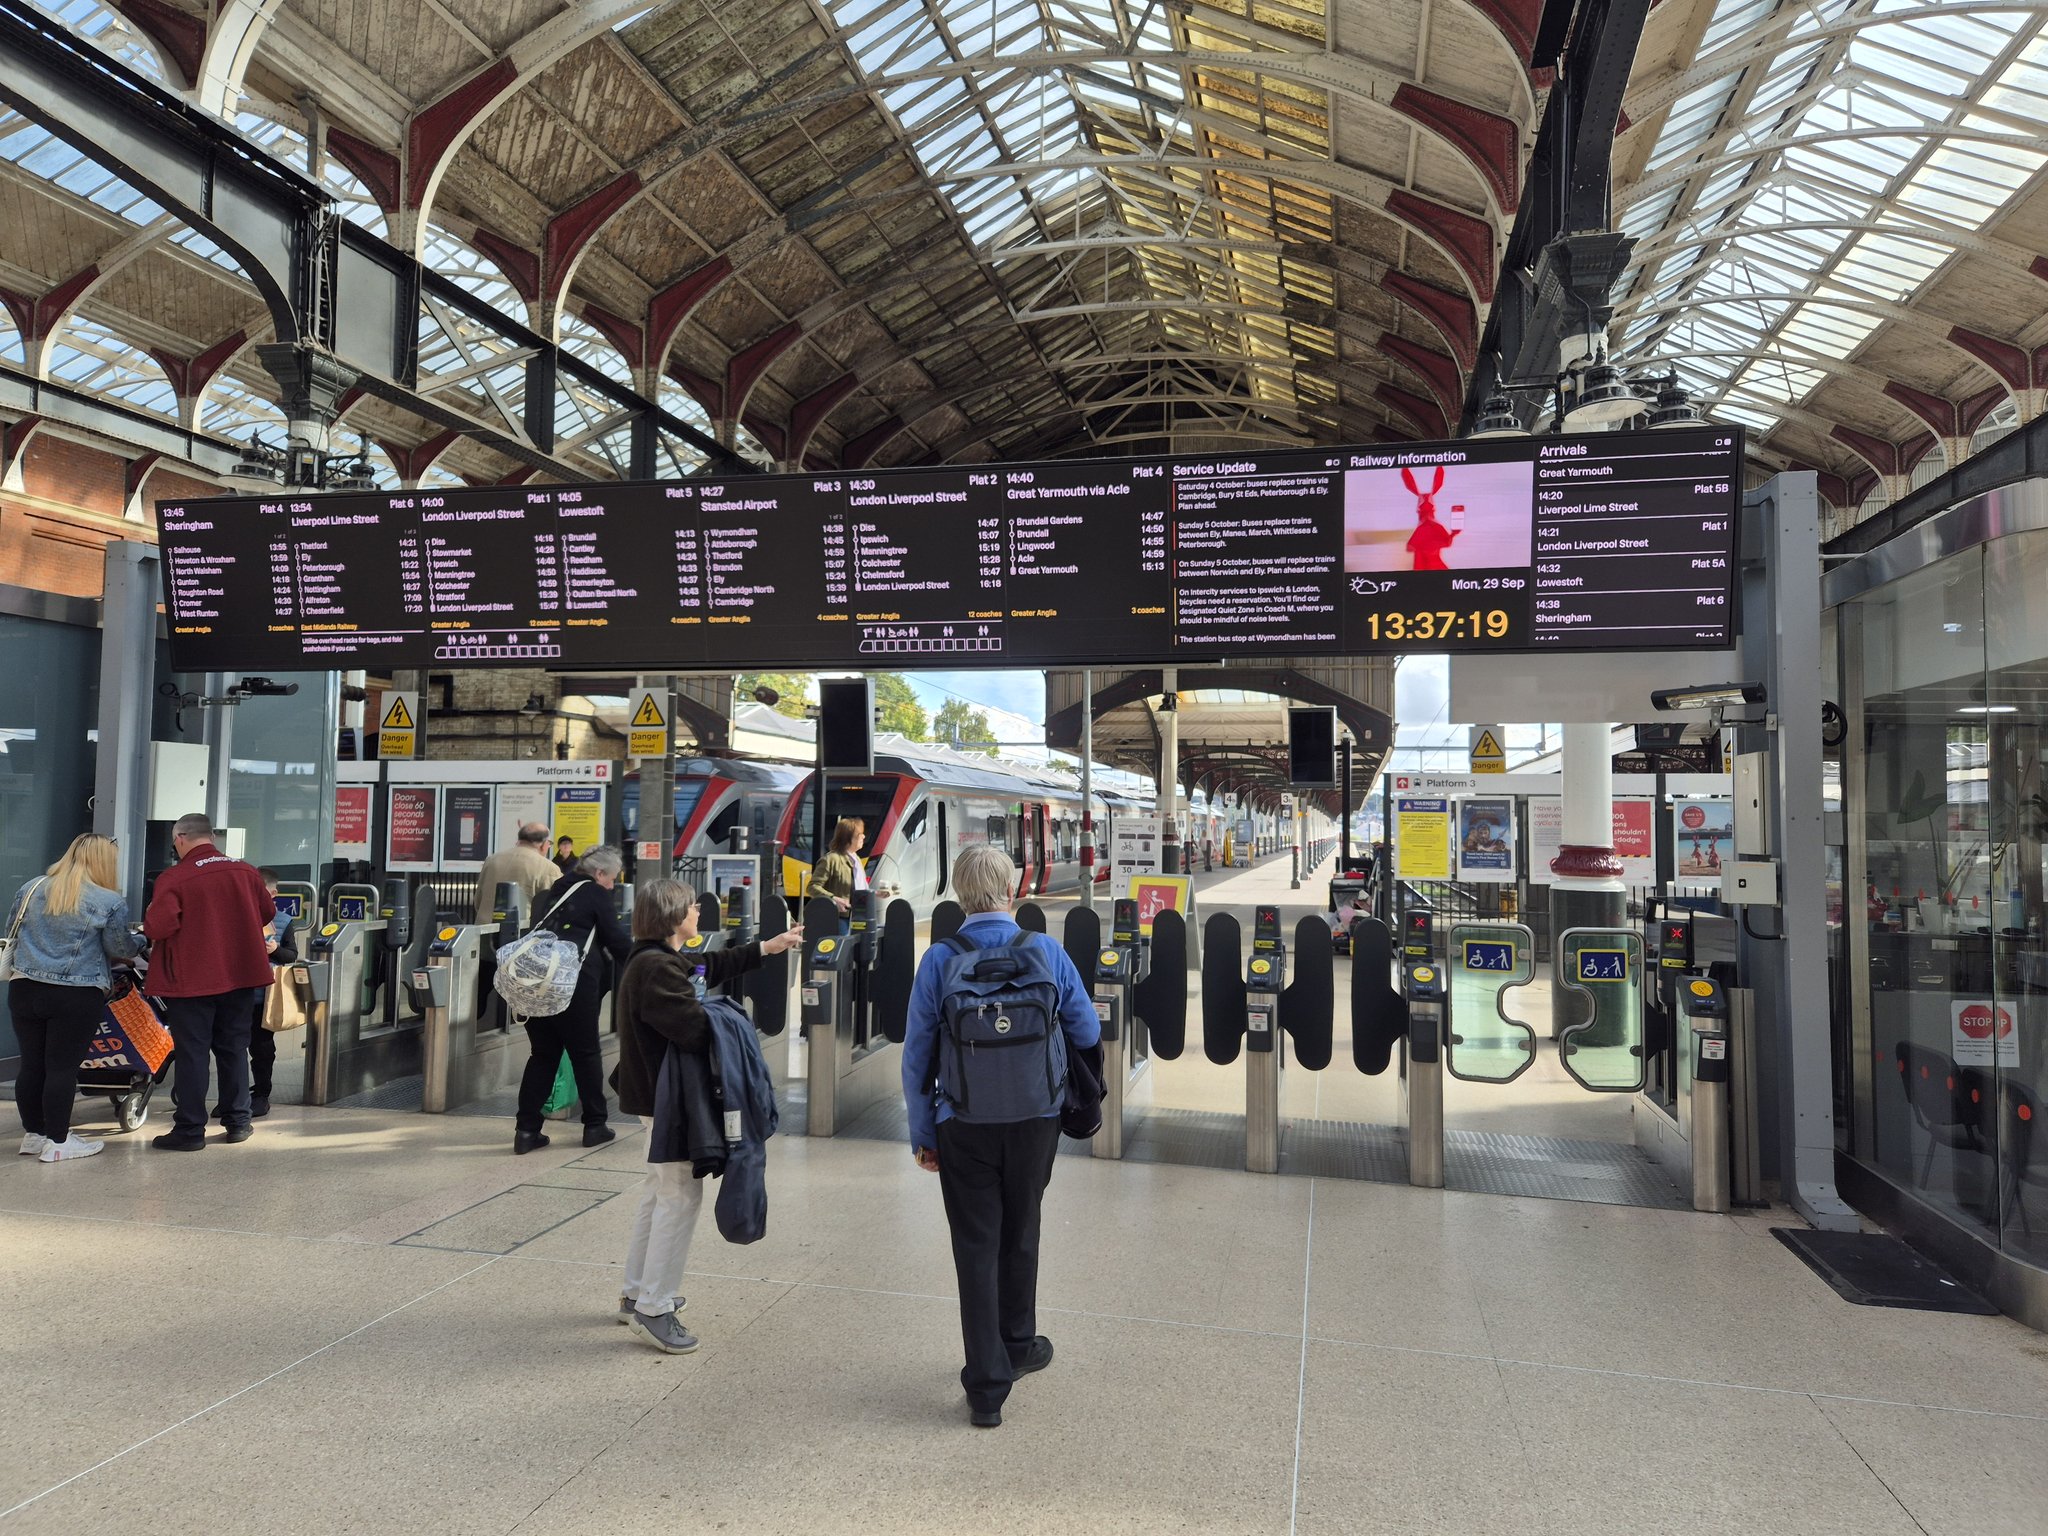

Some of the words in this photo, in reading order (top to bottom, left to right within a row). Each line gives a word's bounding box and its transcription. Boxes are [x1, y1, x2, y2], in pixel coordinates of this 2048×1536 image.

[1540, 444, 1588, 457] Arrivals
[1351, 456, 1396, 467] Railway
[1398, 451, 1467, 464] Information
[1133, 467, 1153, 477] Plat
[1155, 466, 1163, 476] 4
[1173, 464, 1214, 475] Service
[1217, 462, 1258, 475] Update
[1540, 469, 1565, 477] Great
[1568, 466, 1612, 476] Yarmouth
[969, 475, 989, 485] Plat
[990, 474, 997, 484] 2
[1007, 472, 1034, 483] 14:40
[814, 482, 833, 492] Plat
[834, 481, 841, 491] 3
[849, 480, 875, 490] 14:30
[1178, 483, 1210, 491] Saturday
[1216, 481, 1247, 489] October:
[1267, 479, 1296, 488] replace
[1695, 484, 1713, 493] Plat
[1715, 484, 1728, 492] 5B
[666, 488, 686, 498] Plat
[685, 487, 692, 497] 5
[700, 486, 724, 496] 14:27
[1007, 489, 1036, 499] Great
[1038, 486, 1088, 498] Yarmouth
[1089, 485, 1105, 495] via
[1107, 484, 1130, 495] Acle
[1219, 491, 1235, 499] Bury
[1260, 488, 1308, 496] Peterborough
[1539, 491, 1563, 500] 14:20
[528, 494, 545, 503] Plat
[546, 494, 550, 502] 1
[558, 492, 582, 502] 14:05
[850, 495, 887, 506] London
[889, 492, 934, 505] Liverpool
[936, 491, 967, 502] Street
[390, 499, 406, 508] Plat
[407, 499, 414, 508] 6
[421, 497, 444, 507] 14:00
[701, 500, 743, 511] Stansted
[744, 500, 777, 511] Airport
[260, 505, 276, 513] Plat
[275, 504, 283, 513] 4
[290, 503, 312, 512] 13:54
[559, 506, 604, 517] Lowestoft
[1539, 504, 1581, 515] Liverpool
[1584, 504, 1607, 512] Lime
[1609, 502, 1638, 511] Street
[163, 508, 184, 517] 13:45
[423, 512, 454, 521] London
[456, 510, 496, 521] Liverpool
[497, 509, 525, 519] Street
[1142, 512, 1164, 520] 14:47
[292, 516, 330, 527] Liverpool
[331, 516, 352, 525] Lime
[353, 515, 379, 524] Street
[978, 518, 999, 527] 14:47
[1017, 517, 1048, 526] Brundall
[1050, 516, 1083, 524] Gardens
[1703, 522, 1721, 530] Plat
[1723, 521, 1727, 530] 1
[165, 521, 213, 531] Sheringham
[860, 523, 876, 531] Diss
[1142, 524, 1164, 533] 14:50
[710, 528, 757, 538] Wymondham
[978, 531, 999, 539] 15:07
[1017, 529, 1049, 538] Brundall
[1538, 528, 1559, 536] 14:21
[860, 535, 889, 545] Ipswich
[1142, 537, 1164, 546] 14:55
[979, 543, 1000, 551] 15:19
[1017, 541, 1055, 551] Lingwood
[1538, 542, 1572, 551] London
[1574, 539, 1617, 550] Liverpool
[1619, 539, 1649, 548] Street
[712, 551, 742, 559] Thetford
[861, 547, 907, 556] Manningtree
[1142, 550, 1164, 558] 14:59
[979, 555, 1000, 563] 15:28
[1018, 554, 1034, 562] Acle
[861, 559, 901, 567] Colchester
[1142, 562, 1164, 570] 15:13
[1692, 559, 1710, 568] Plat
[1712, 559, 1725, 567] 5A
[980, 567, 1000, 575] 15:47
[1039, 565, 1078, 574] Yarmouth
[1537, 564, 1560, 573] 14:32
[862, 570, 904, 579] Chelmsford
[863, 583, 890, 591] London
[891, 582, 925, 591] Liverpool
[926, 581, 949, 589] Street
[980, 580, 1001, 588] 16:18
[1452, 579, 1480, 590] Mon,
[1483, 578, 1499, 589] 29
[1502, 578, 1525, 590] Sep
[1537, 577, 1583, 587] Lowestoft
[572, 601, 607, 609] Lowestoft
[1536, 600, 1560, 609] 14:38
[1697, 596, 1715, 605] Plat
[1717, 596, 1724, 604] 6
[1536, 613, 1591, 624] Sheringham
[1368, 610, 1508, 639] 13:37:19
[381, 734, 408, 742] Danger
[537, 767, 573, 775] Platform
[394, 793, 416, 801] Doors
[394, 802, 413, 810] close
[414, 801, 425, 810] 60
[393, 810, 424, 818] seconds
[394, 818, 417, 826] before
[393, 826, 430, 835] departure.
[1614, 828, 1646, 836] shouldn't
[1964, 1017, 1991, 1026] STOP
